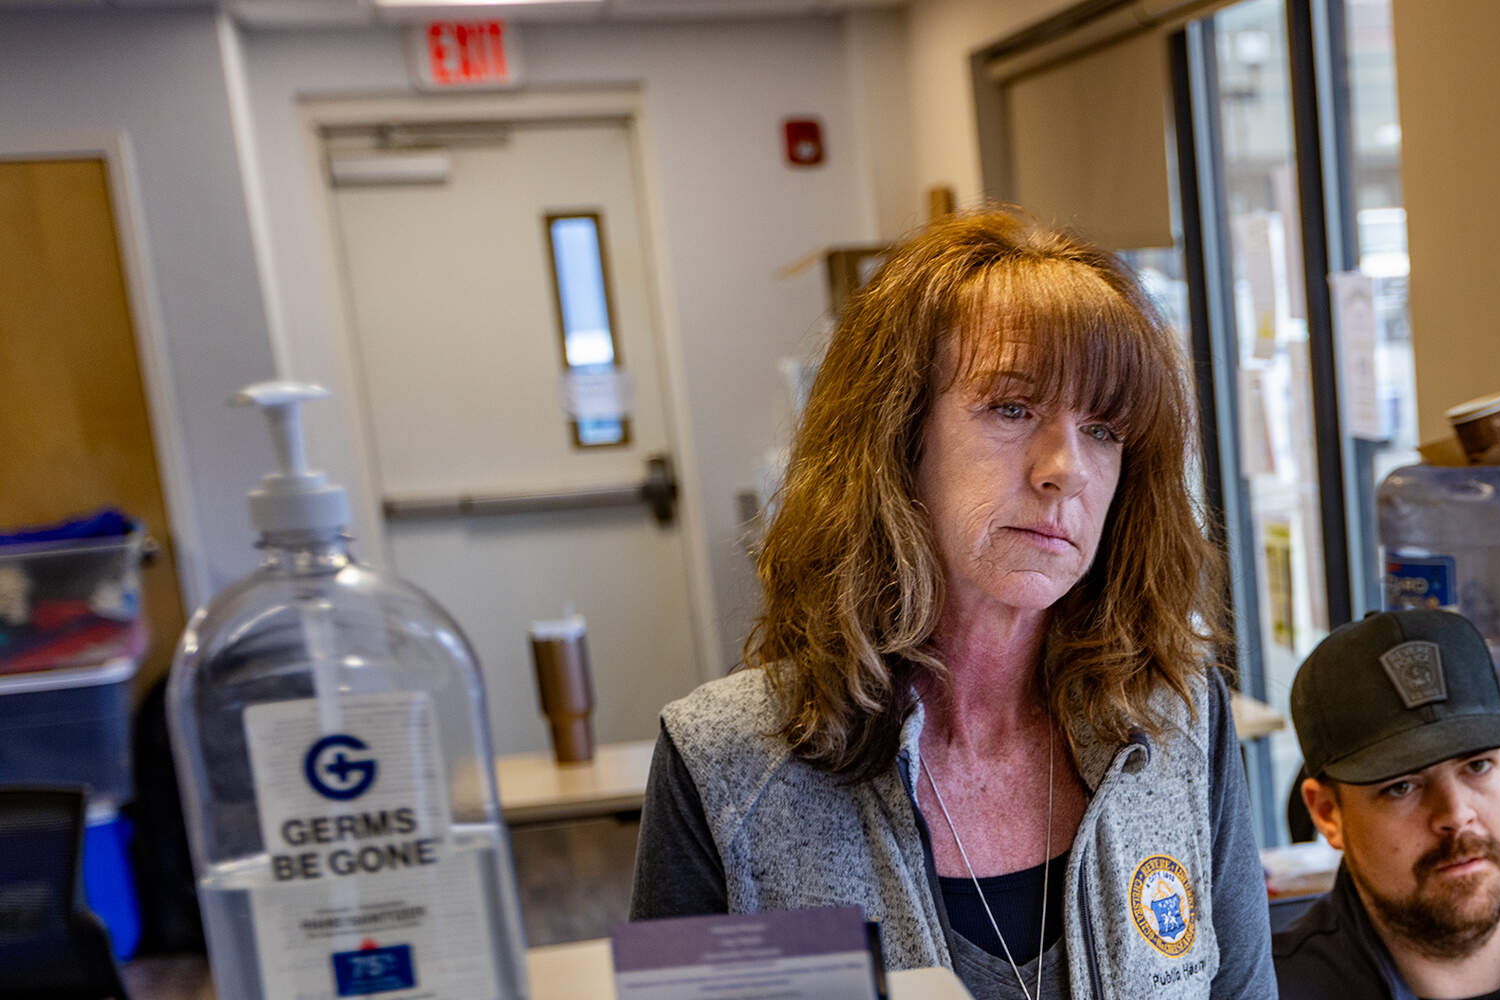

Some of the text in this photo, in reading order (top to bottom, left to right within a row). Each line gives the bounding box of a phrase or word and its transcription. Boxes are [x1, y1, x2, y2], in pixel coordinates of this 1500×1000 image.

[427, 20, 507, 84] EXIT
[280, 807, 418, 847] GERMS
[271, 838, 439, 882] BE GONE
[1152, 966, 1181, 987] Public
